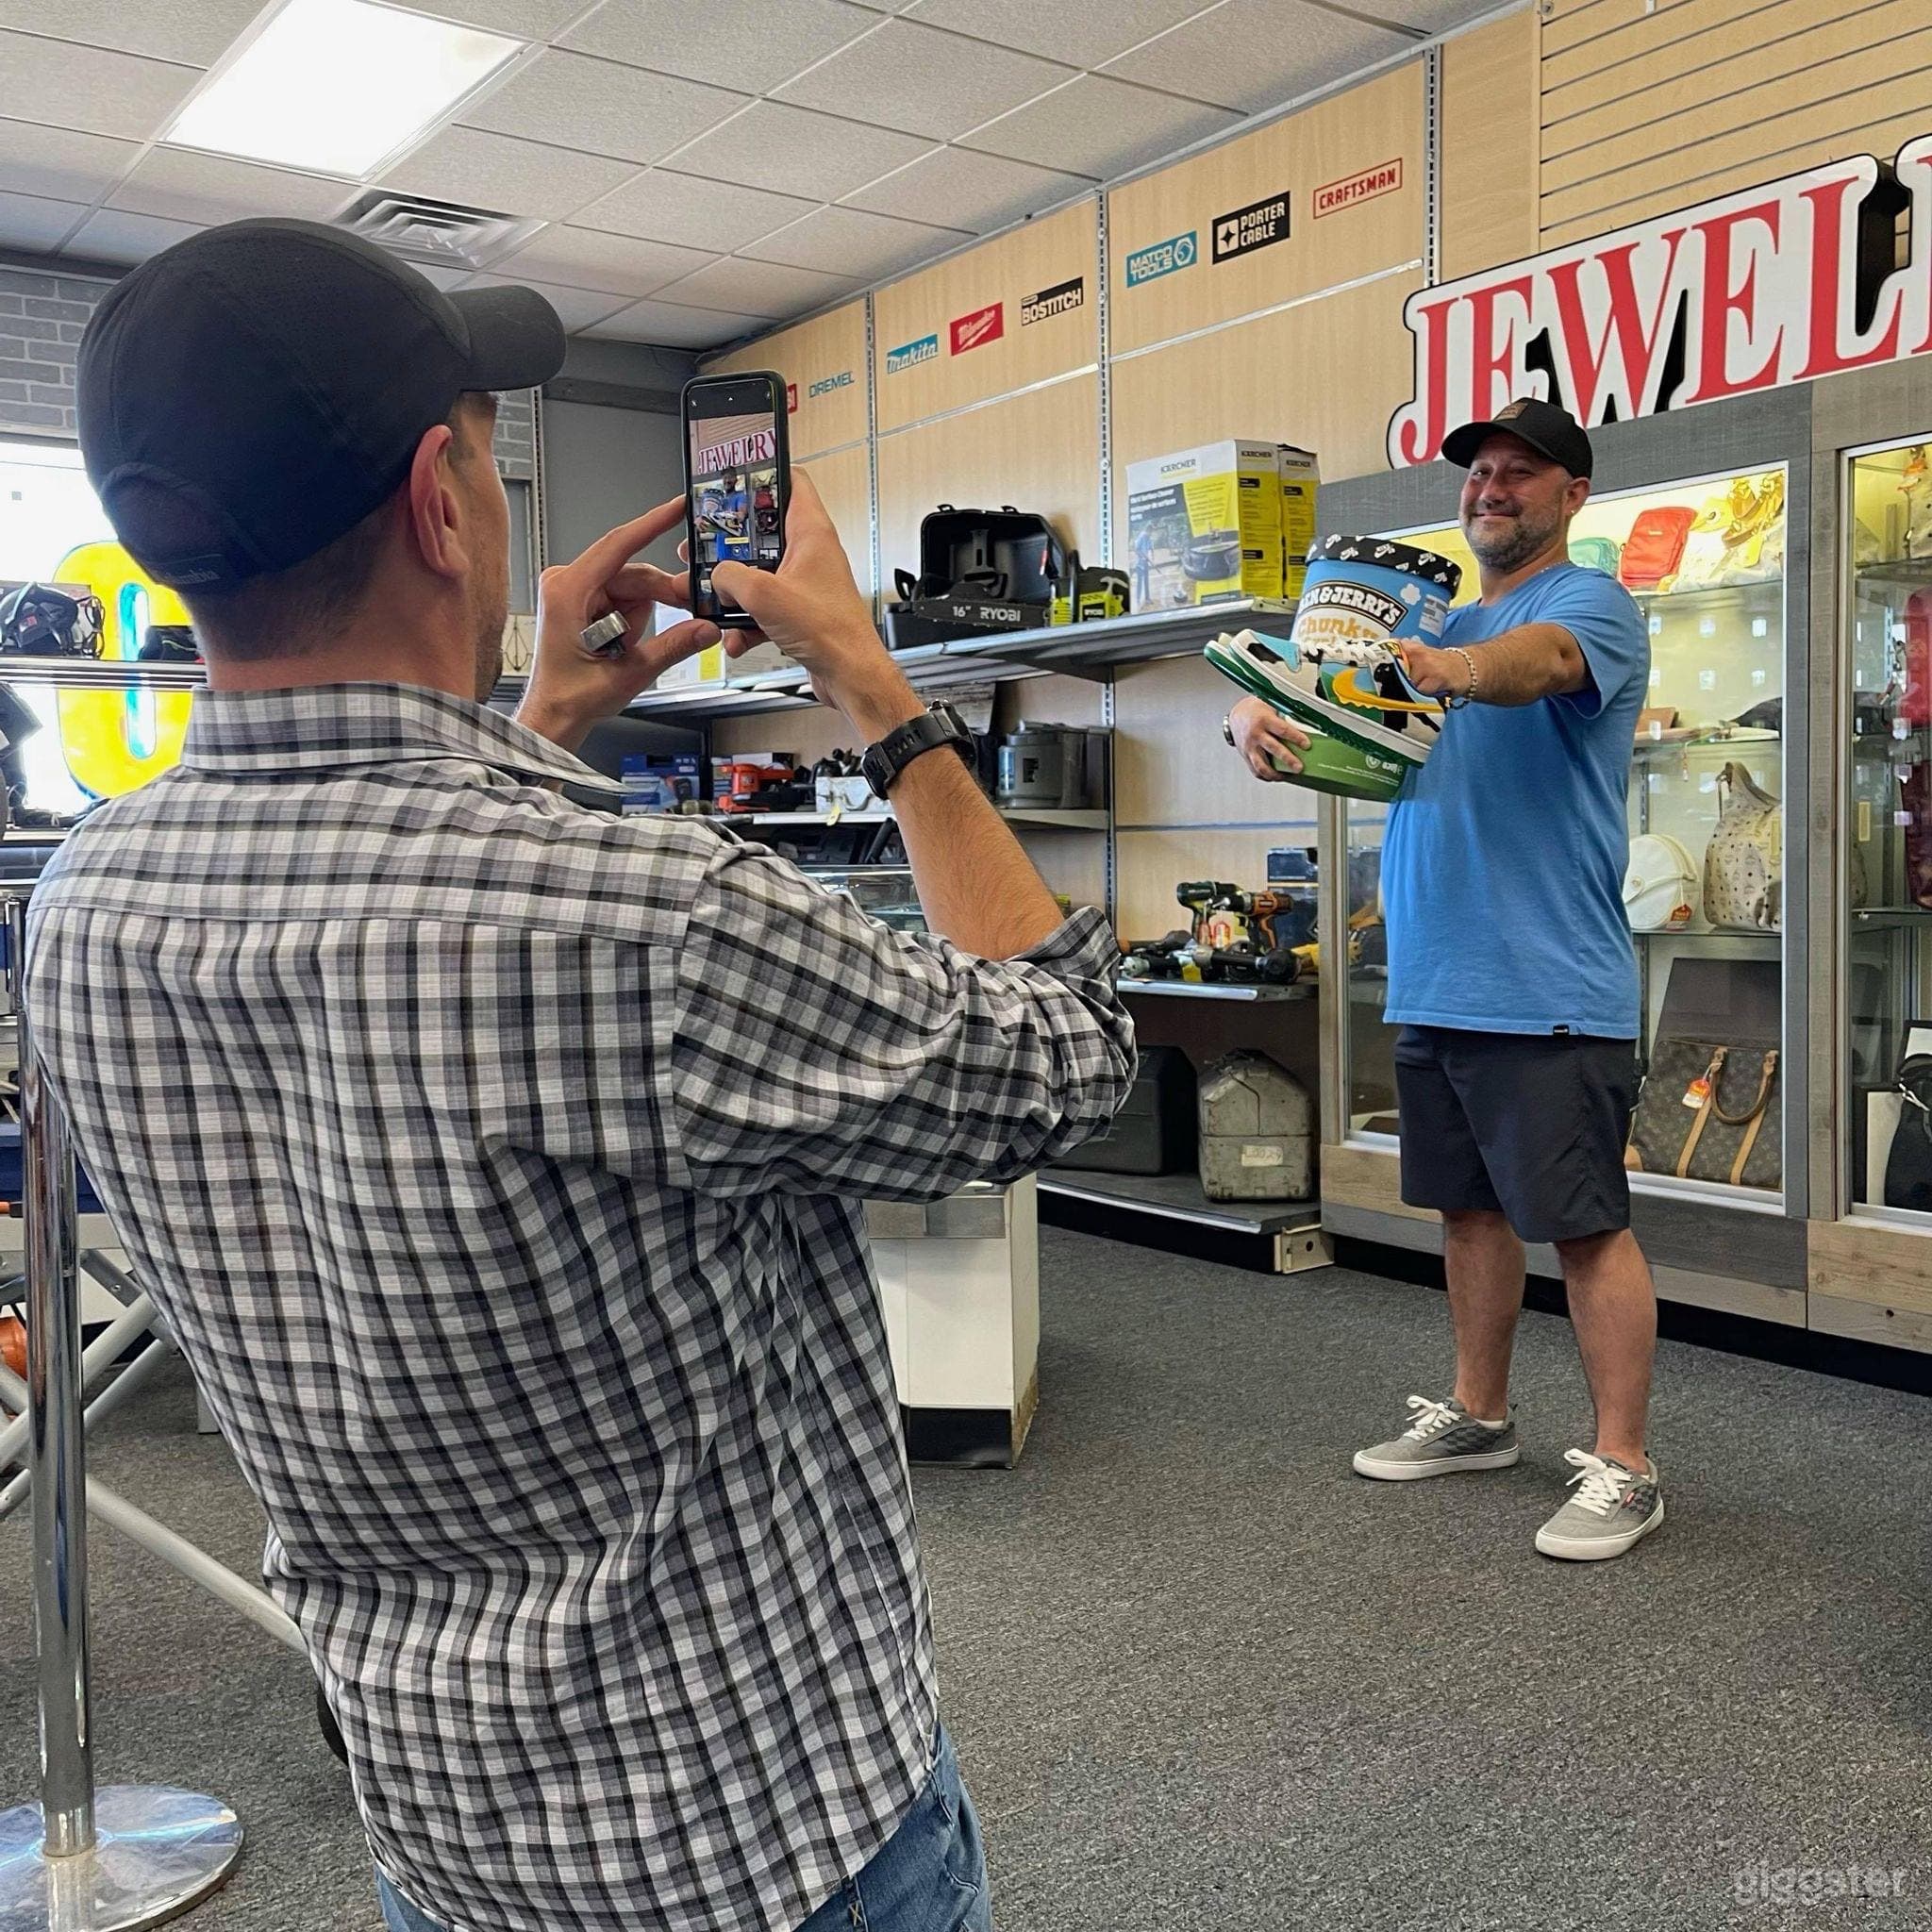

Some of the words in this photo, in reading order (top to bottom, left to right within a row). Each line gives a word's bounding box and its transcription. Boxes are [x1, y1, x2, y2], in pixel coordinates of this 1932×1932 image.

[1318, 168, 1397, 209] CRAFTSMAN
[1240, 201, 1286, 231] PORTER
[1240, 223, 1276, 247] CABLE
[1130, 244, 1172, 271] MATCO
[1130, 257, 1174, 282] TOOLS
[1022, 288, 1082, 325] BOSTITCH
[1400, 156, 1932, 466] JEWEL
[808, 371, 855, 398] DREMEL
[952, 606, 972, 618] 16"
[979, 607, 1022, 622] RYOBI
